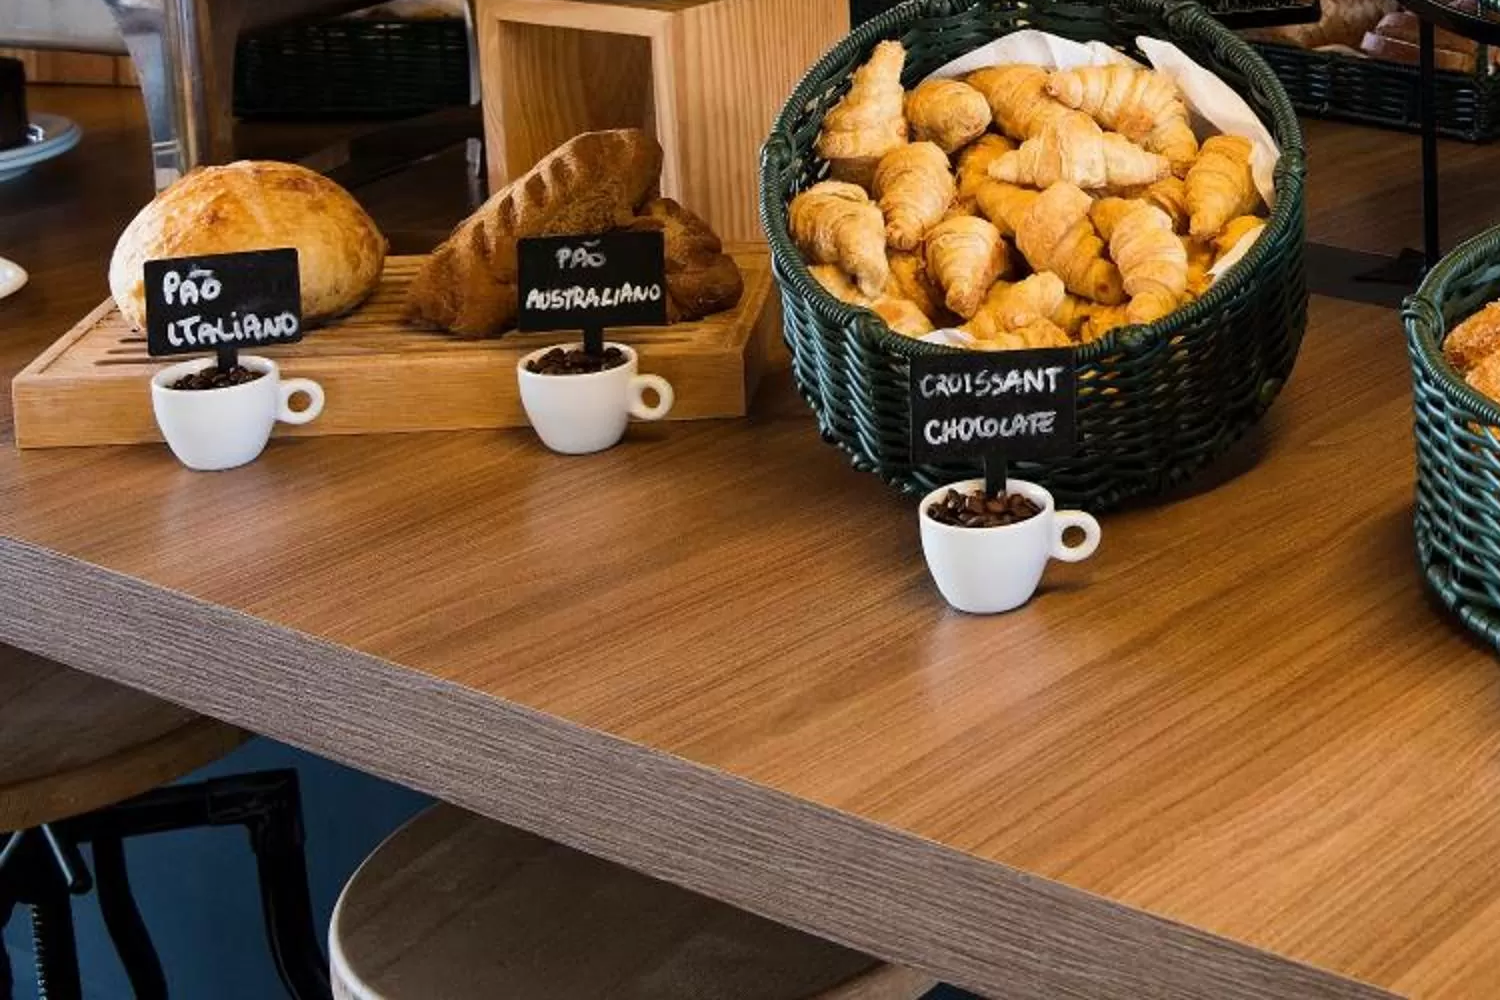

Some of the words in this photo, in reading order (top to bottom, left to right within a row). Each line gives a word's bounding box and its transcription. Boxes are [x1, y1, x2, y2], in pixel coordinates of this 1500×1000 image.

[525, 281, 662, 311] AUSTRALIANO
[919, 366, 1064, 399] CROISSANT
[923, 411, 1057, 445] CHOCOLATE
